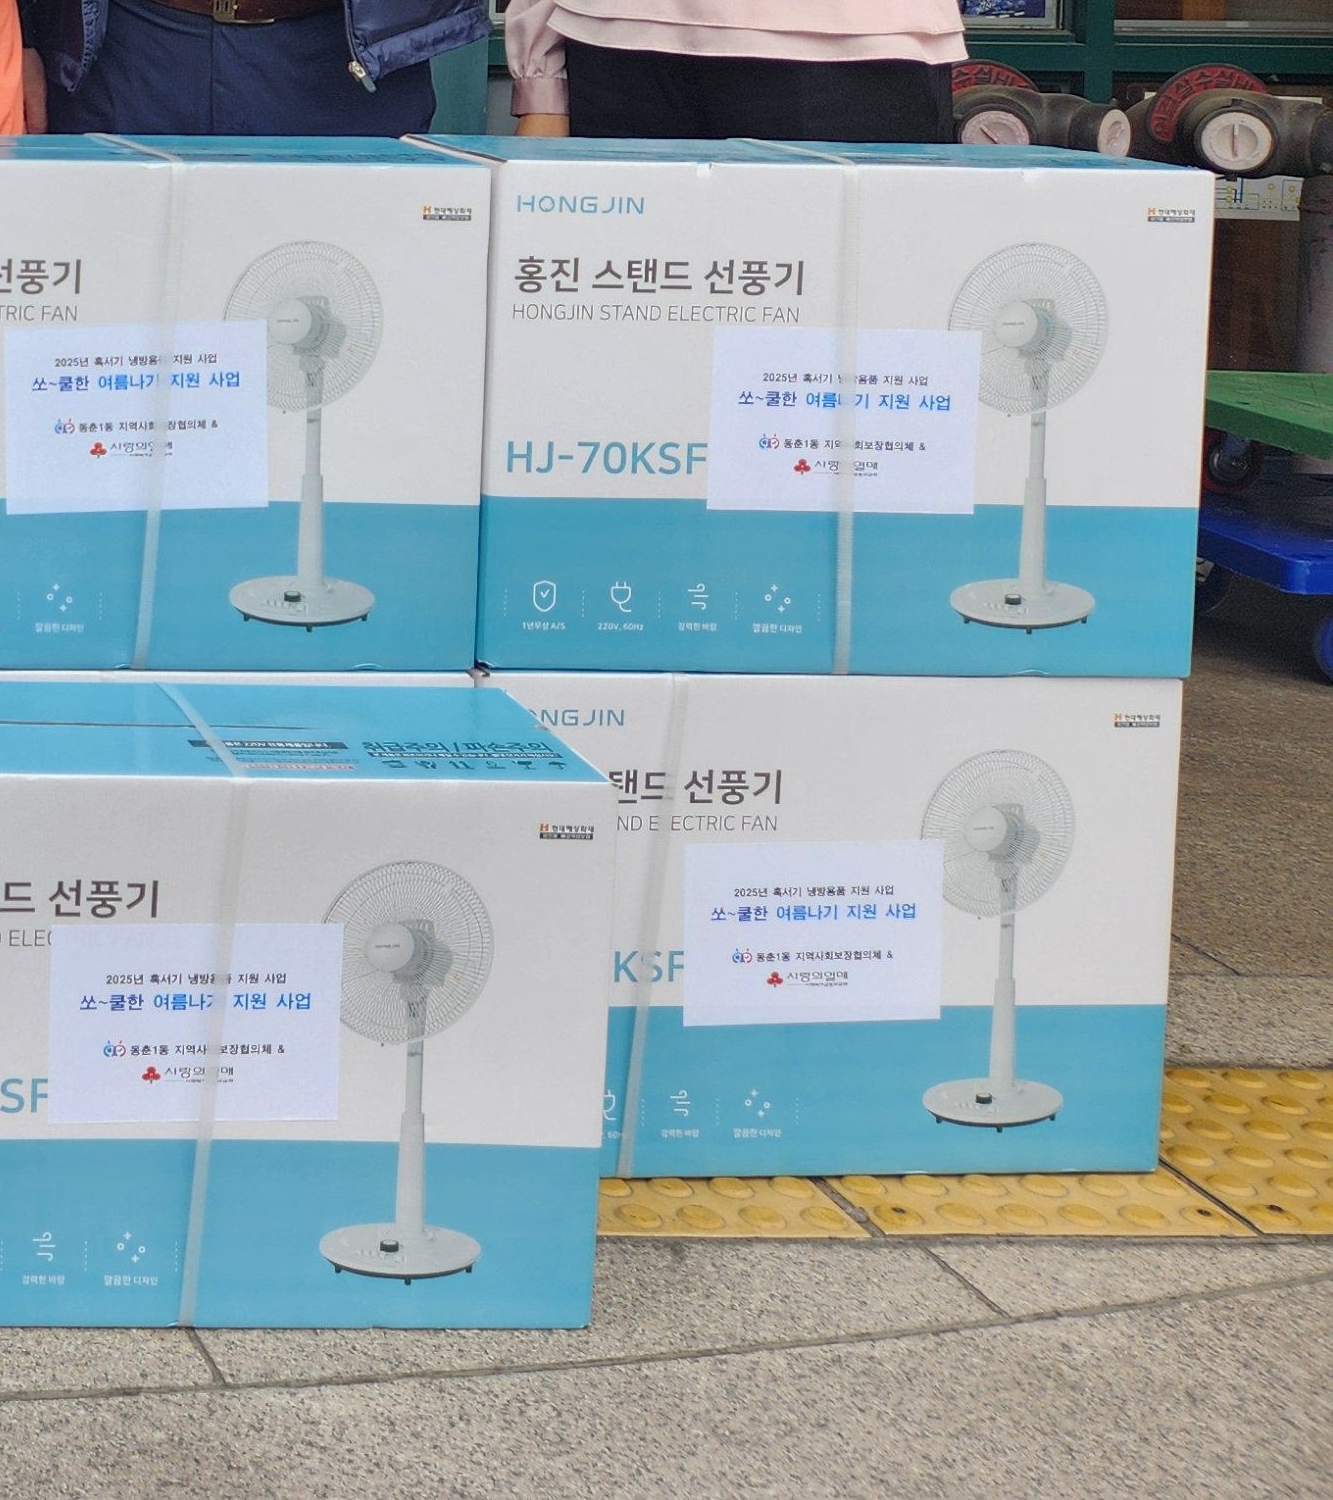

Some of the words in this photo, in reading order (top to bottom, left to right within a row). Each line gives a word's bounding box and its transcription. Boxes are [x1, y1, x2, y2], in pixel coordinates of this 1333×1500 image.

[517, 195, 644, 214] HONGJIN
[515, 256, 579, 293] 홍진
[592, 259, 692, 293] 스탠드
[705, 260, 803, 295] 선풍기
[507, 441, 707, 474] HJ-70KSF
[684, 770, 781, 805] 선풍기
[742, 816, 777, 831] FAN
[49, 880, 158, 918] 선풍기
